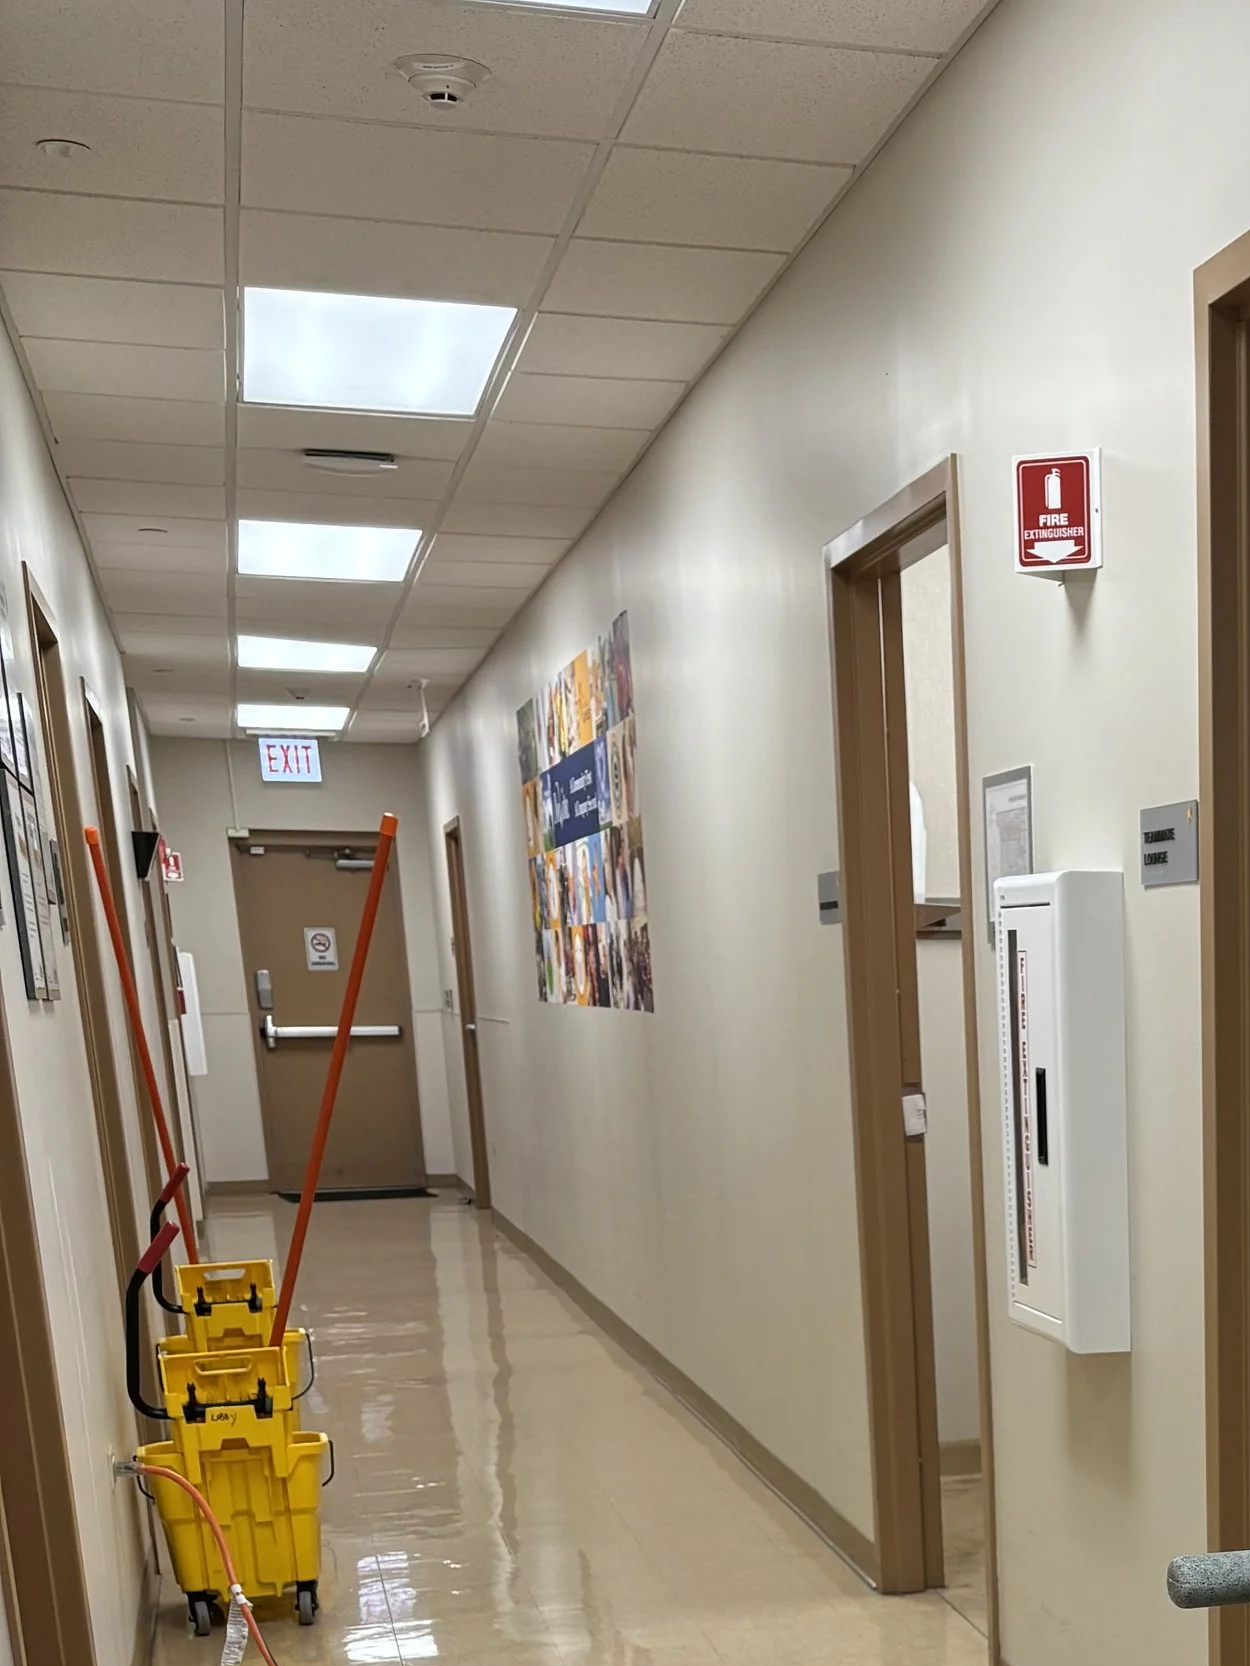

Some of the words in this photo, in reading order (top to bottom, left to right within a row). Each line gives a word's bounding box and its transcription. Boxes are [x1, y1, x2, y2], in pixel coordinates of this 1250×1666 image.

[1039, 513, 1069, 527] FIRE
[1024, 527, 1084, 540] EXTINGUISHER
[266, 744, 312, 774] EXIT
